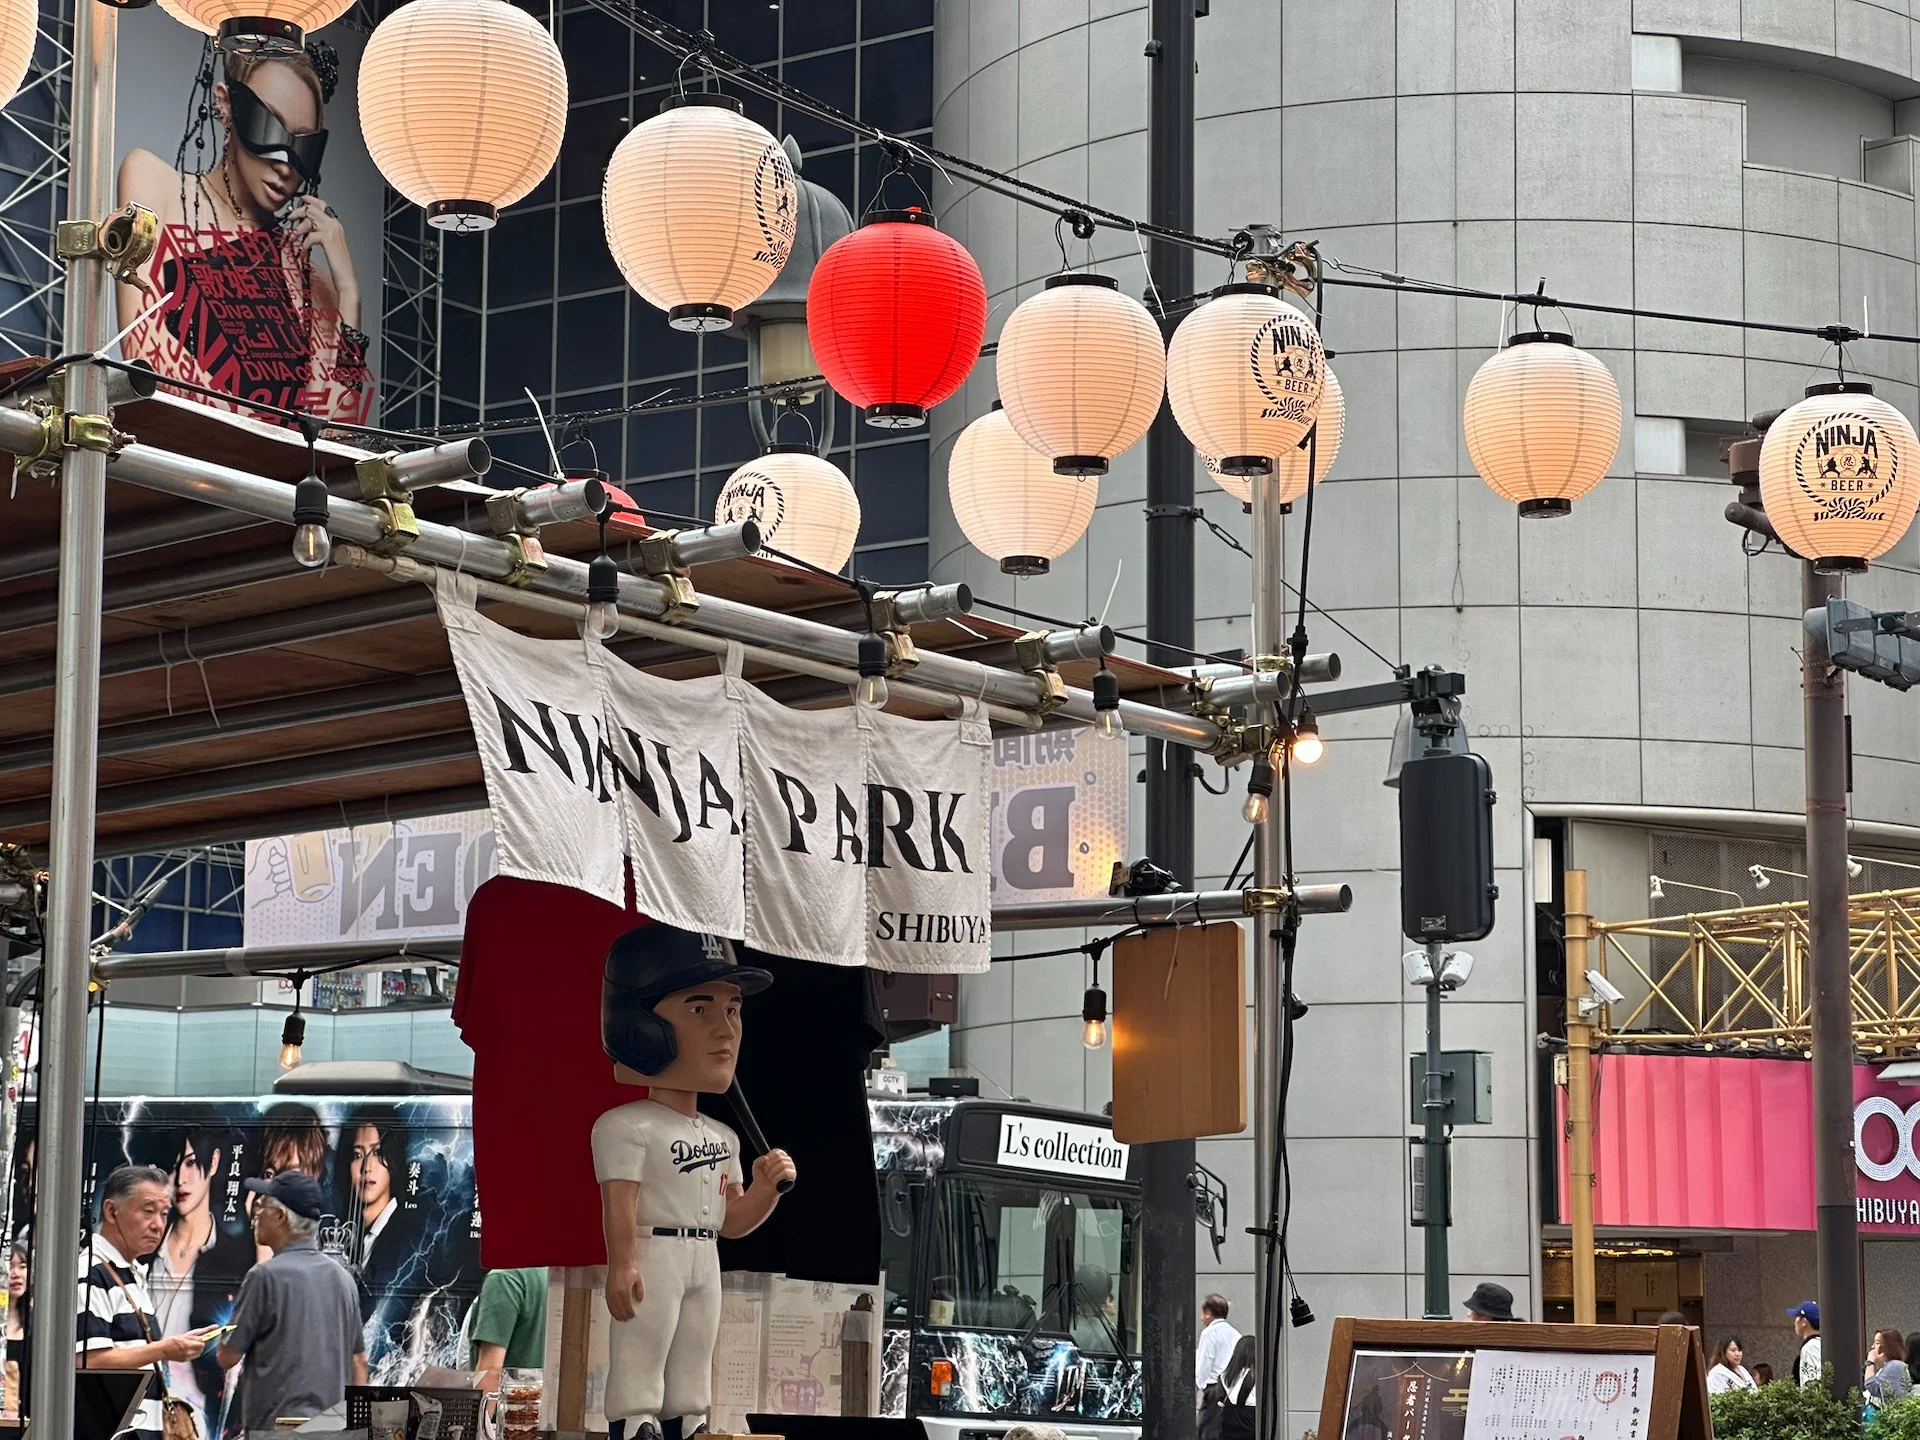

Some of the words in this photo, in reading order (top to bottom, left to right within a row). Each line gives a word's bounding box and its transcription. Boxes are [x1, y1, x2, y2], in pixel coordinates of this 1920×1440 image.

[165, 219, 281, 265] 日本的
[207, 299, 255, 319] Diva
[255, 304, 284, 325] ng
[241, 361, 297, 382] DIVA
[295, 362, 317, 382] of
[319, 362, 376, 383] Japan
[1284, 379, 1310, 395] BEER
[1815, 424, 1878, 460] NINJA
[1831, 479, 1864, 492] BEER
[487, 686, 747, 843] NINJA
[769, 766, 973, 874] PARK
[875, 910, 986, 944] SHIBUYA
[1003, 1123, 1030, 1158] L's
[1033, 1129, 1123, 1169] collection
[224, 1144, 243, 1213] 平良翔太
[223, 1213, 236, 1222] Leo
[404, 1201, 418, 1209] Leo
